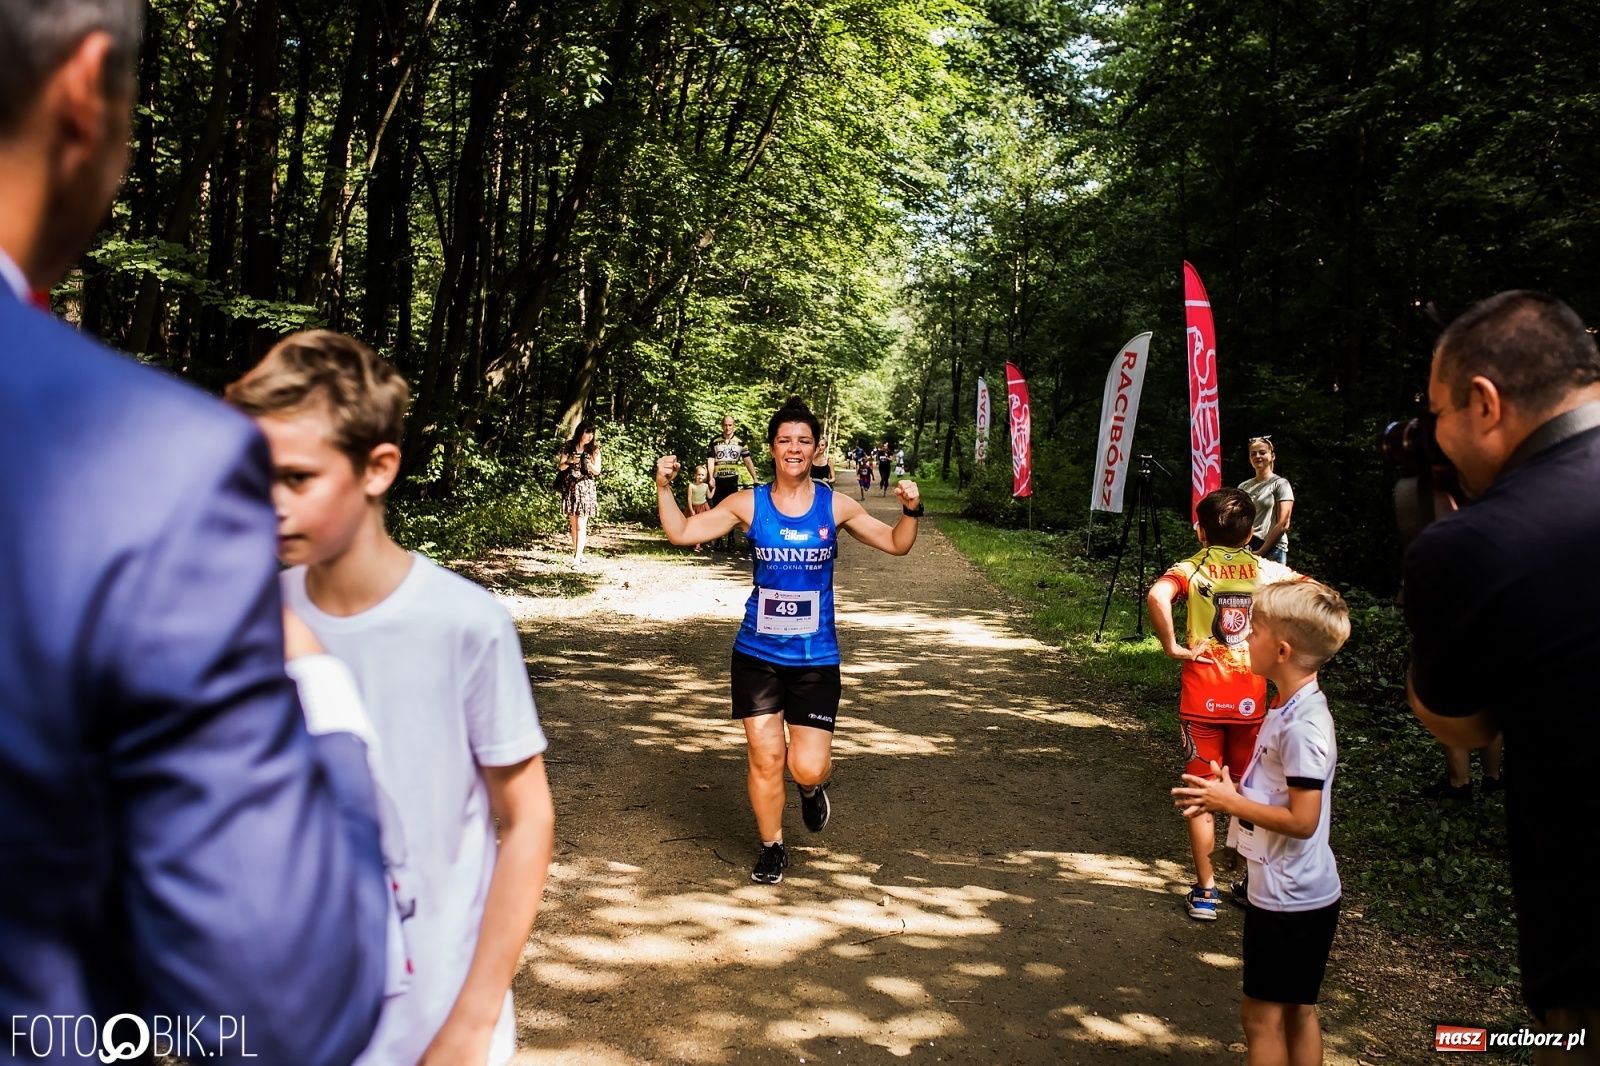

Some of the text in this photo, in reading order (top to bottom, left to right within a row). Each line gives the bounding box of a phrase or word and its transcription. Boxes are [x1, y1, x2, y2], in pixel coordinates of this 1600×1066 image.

[1102, 351, 1138, 507] RACIBÓRZ
[754, 546, 833, 562] RUNNERS
[775, 601, 798, 615] 49
